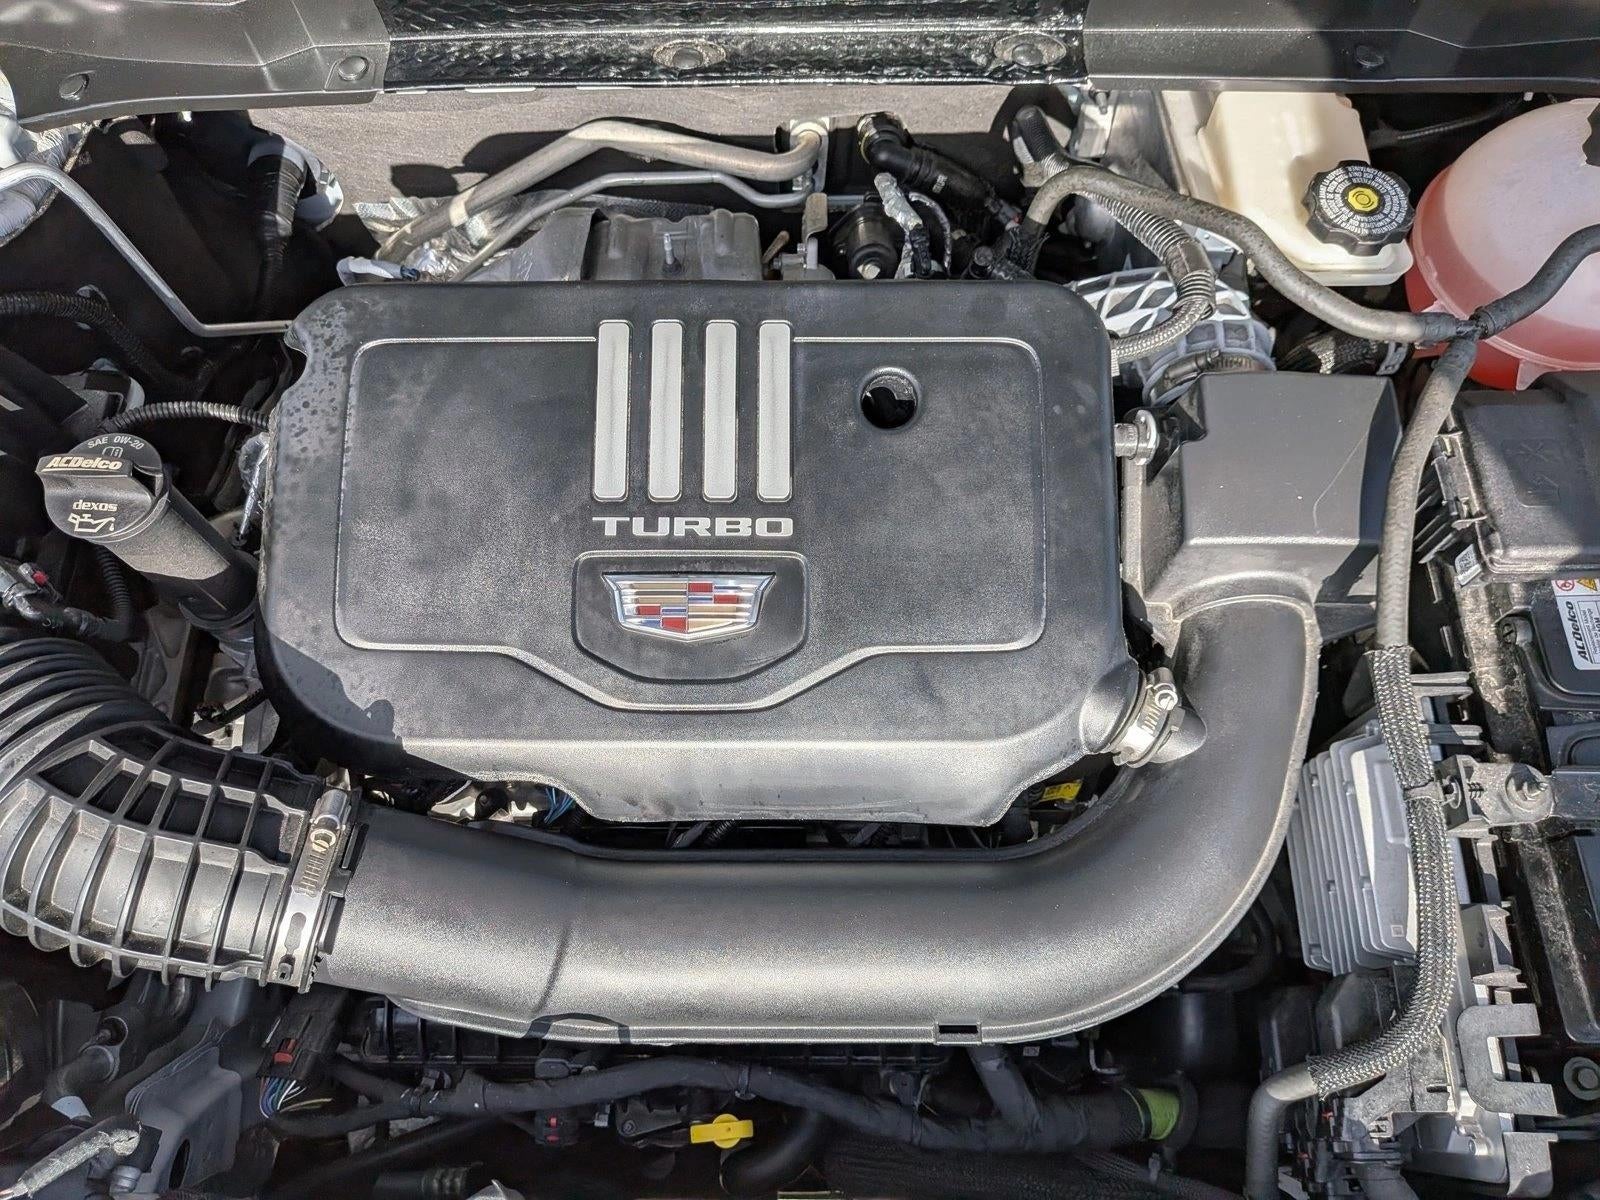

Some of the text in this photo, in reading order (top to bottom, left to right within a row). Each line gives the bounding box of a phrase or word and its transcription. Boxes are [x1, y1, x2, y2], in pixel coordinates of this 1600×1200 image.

[87, 435, 145, 450] SAE 0W-20
[45, 456, 123, 470] ACDelco
[72, 499, 118, 512] dexos
[592, 517, 794, 537] TURBO
[1565, 601, 1588, 661] ACDelco
